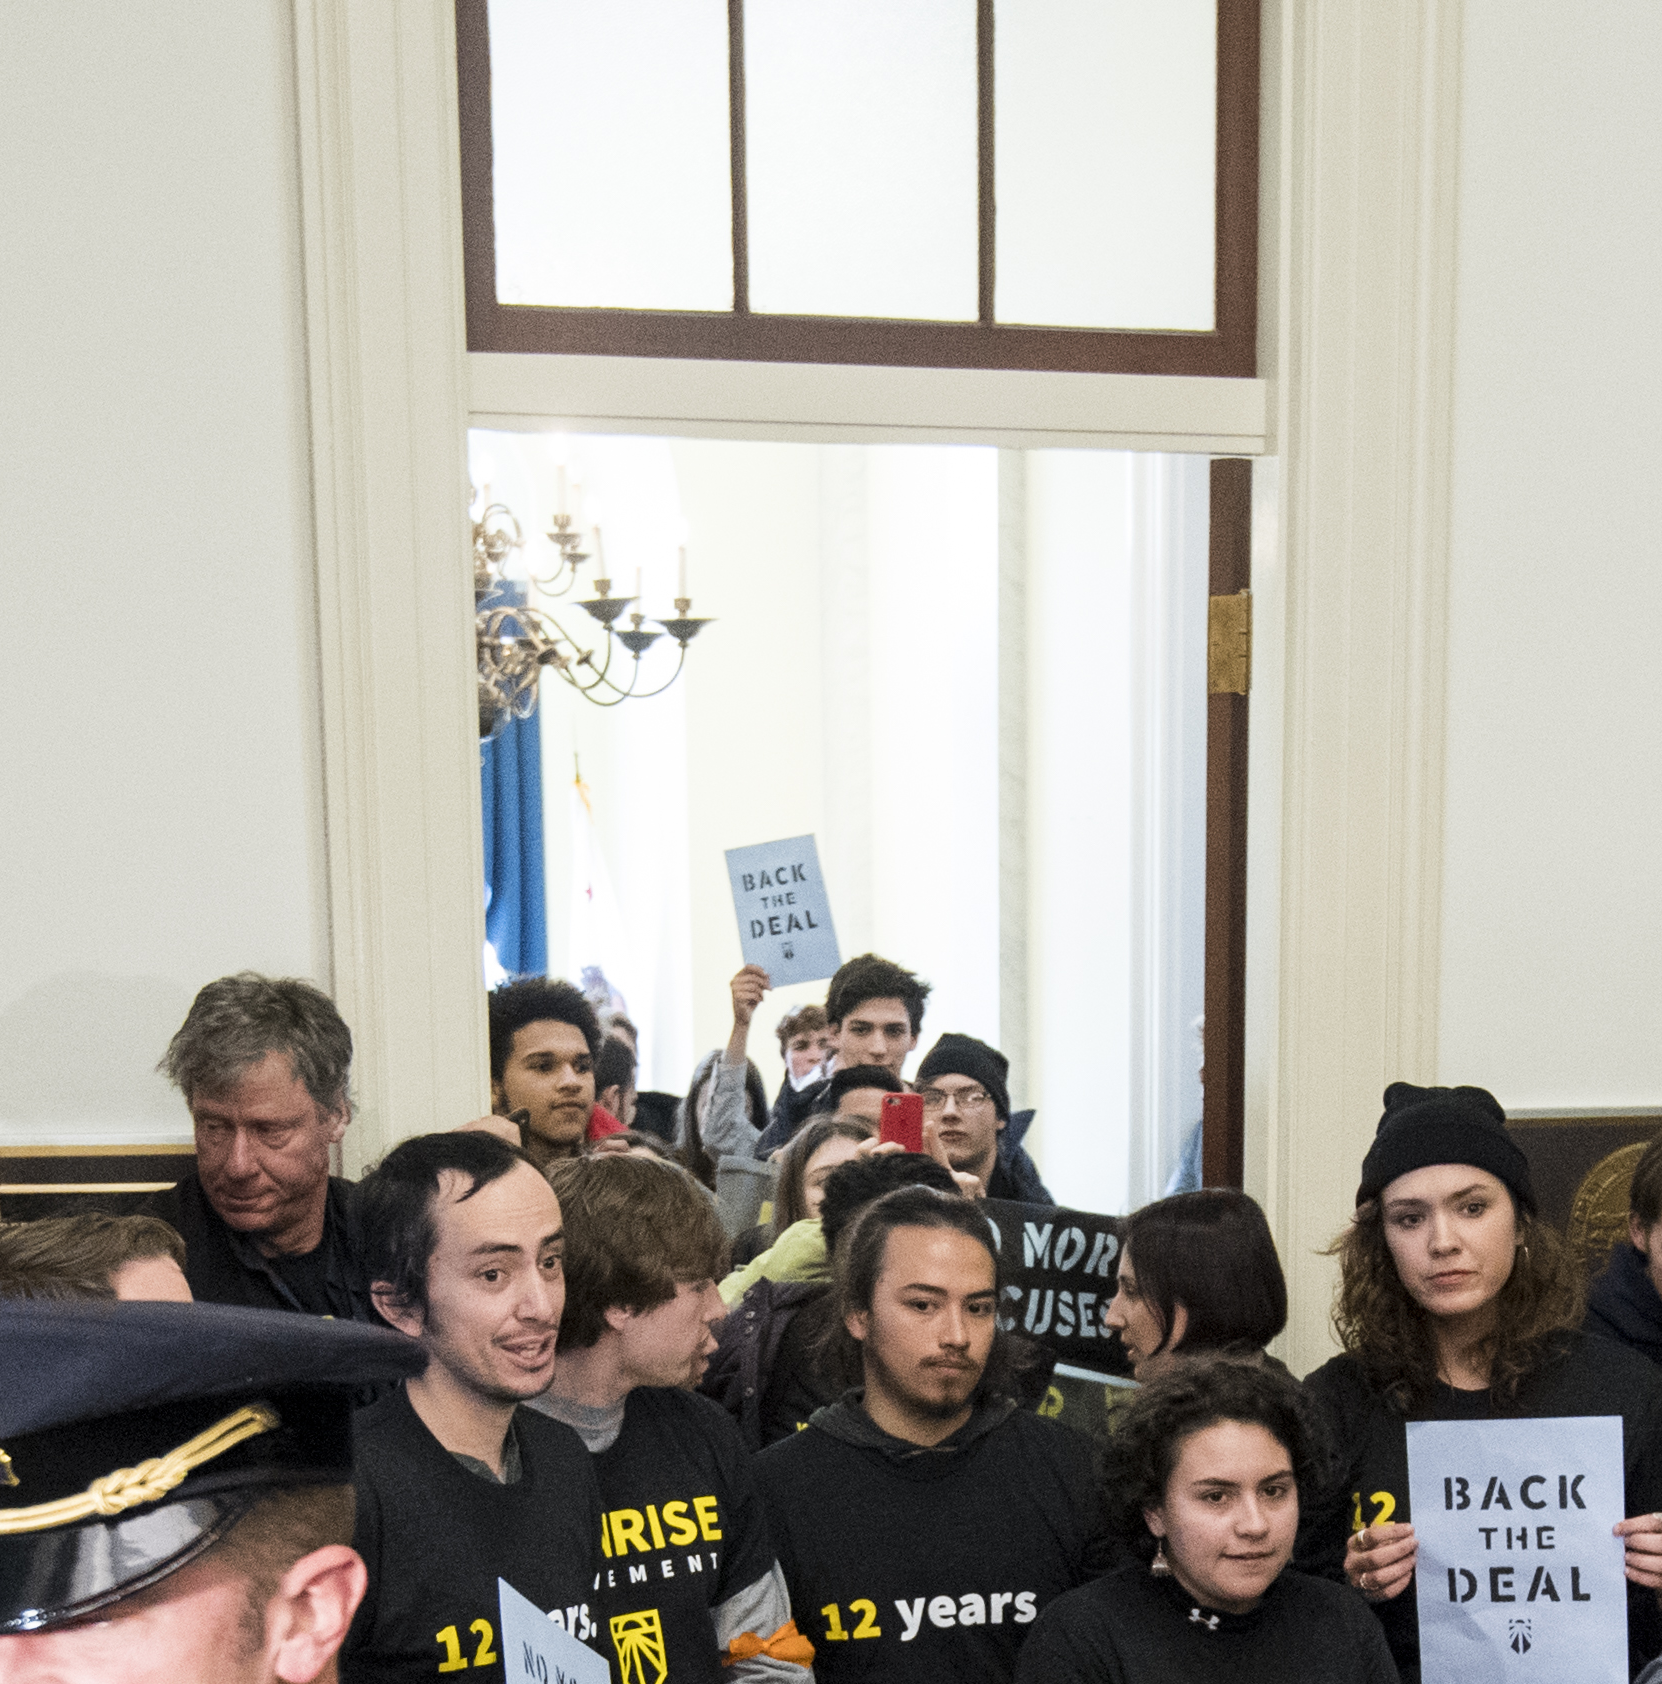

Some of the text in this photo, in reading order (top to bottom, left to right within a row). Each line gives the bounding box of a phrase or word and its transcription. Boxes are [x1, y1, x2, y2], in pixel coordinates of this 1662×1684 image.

[741, 863, 807, 892] BACK
[760, 892, 797, 909] THE
[749, 910, 819, 940] DEAL
[1023, 1221, 1119, 1278] MOR
[1443, 1474, 1588, 1513] BACK
[1478, 1525, 1556, 1551] THE
[1446, 1565, 1592, 1604] DEAL
[820, 1598, 882, 1642] 12
[435, 1618, 498, 1674] 12
